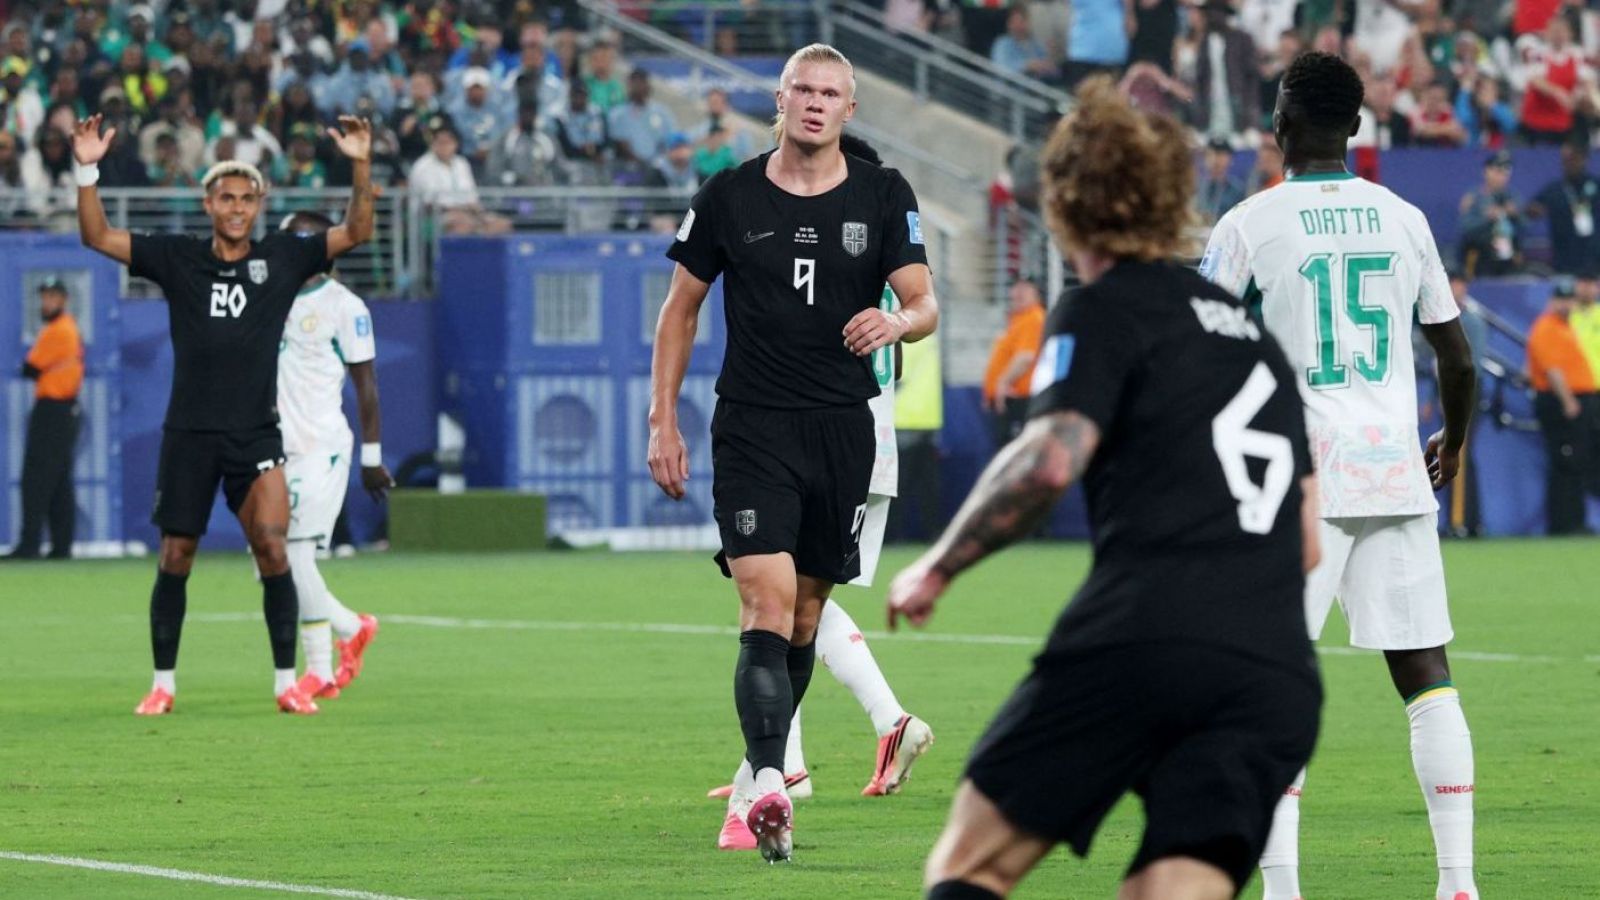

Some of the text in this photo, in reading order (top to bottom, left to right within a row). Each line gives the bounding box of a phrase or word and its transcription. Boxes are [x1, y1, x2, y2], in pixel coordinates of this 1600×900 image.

[1299, 207, 1381, 235] DIATTA
[210, 282, 248, 319] 20
[793, 257, 816, 306] 9
[1299, 252, 1399, 390] 15
[1211, 360, 1295, 534] 6
